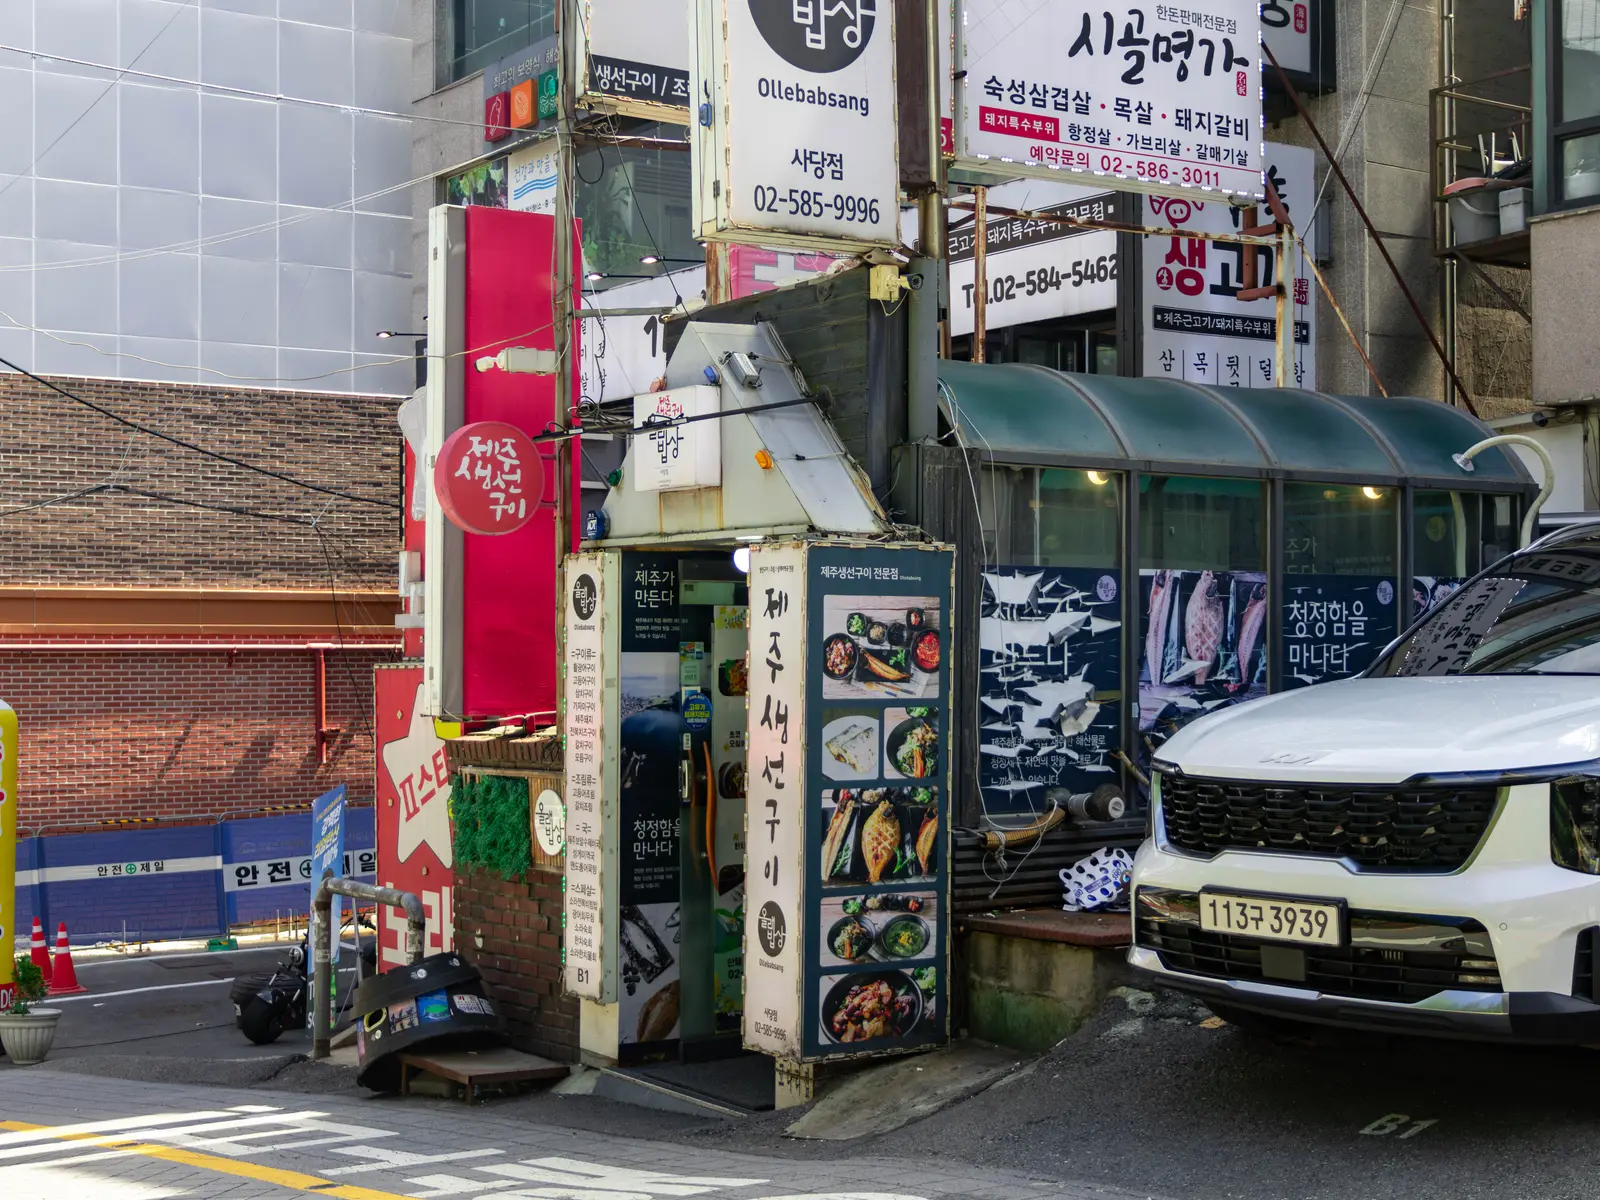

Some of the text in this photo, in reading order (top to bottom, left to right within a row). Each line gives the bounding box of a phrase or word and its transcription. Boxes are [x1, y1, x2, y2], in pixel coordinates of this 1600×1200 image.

[1156, 5, 1237, 34] 한돈판매전문점
[1068, 9, 1250, 85] 시골명가
[596, 64, 655, 93] 생선구이
[758, 78, 869, 117] Ollebabsang
[983, 75, 1249, 141] 숙성삼겹살 목살 돼지갈비
[984, 112, 1249, 166] 돼지특수부위 항정살 가브리살 갈매기살
[791, 149, 843, 180] 사당점
[1029, 145, 1219, 187] 예약문의 02-586-3011
[754, 185, 880, 224] 02-585-9996
[467, 436, 521, 472] 제주
[455, 456, 522, 494] 생선
[489, 491, 526, 522] 구이
[635, 570, 675, 587] 제주가
[820, 565, 872, 579] 제주생선구이
[874, 567, 899, 580] 전문점
[635, 590, 674, 607] 만든다
[1288, 600, 1369, 638] 청정함을
[1289, 643, 1350, 677] 만나다
[761, 588, 788, 886] 제주생선구이
[633, 817, 680, 839] 청정함을
[633, 840, 673, 860] 만나다
[1269, 904, 1329, 939] 3939
[577, 968, 589, 984] B1
[764, 1008, 778, 1022] 사당점
[754, 1021, 787, 1041] 02-585-9996
[1360, 1112, 1438, 1140] B1
